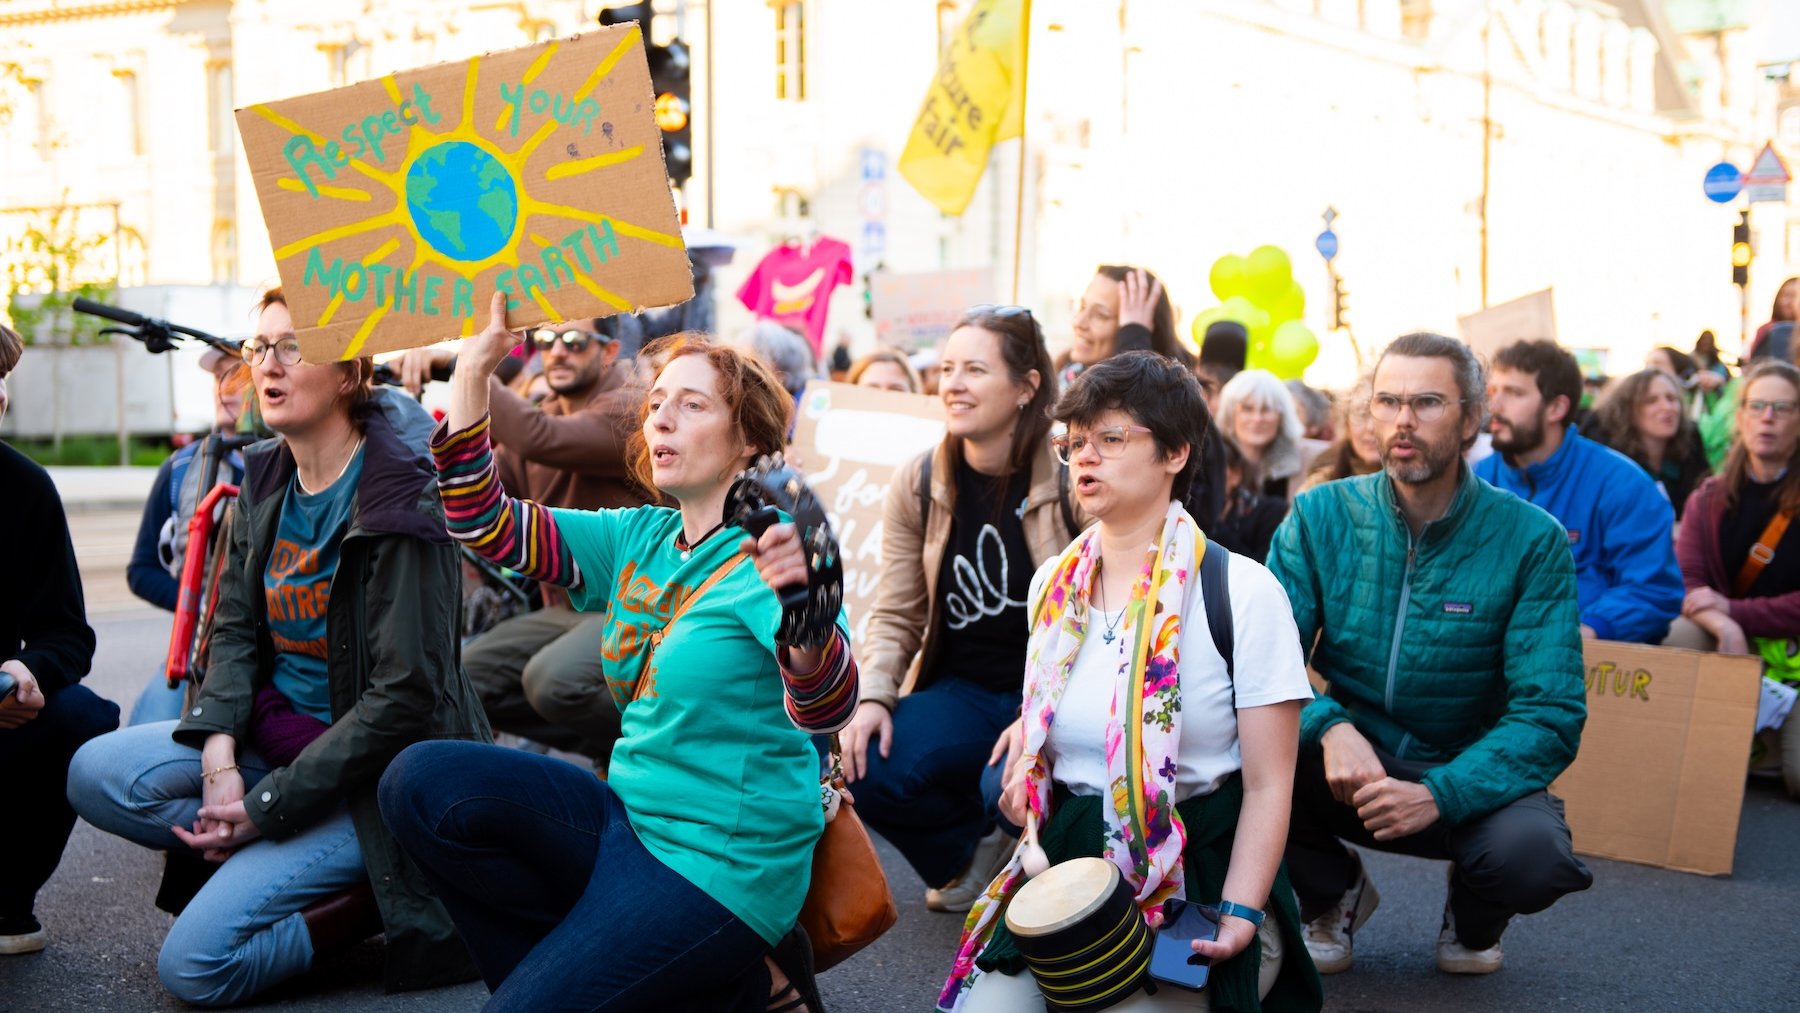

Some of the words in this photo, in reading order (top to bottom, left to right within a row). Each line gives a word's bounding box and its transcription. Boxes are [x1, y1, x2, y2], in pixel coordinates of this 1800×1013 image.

[283, 82, 441, 199] Respect
[303, 246, 474, 317] MOTHER
[495, 217, 620, 312] EARTH
